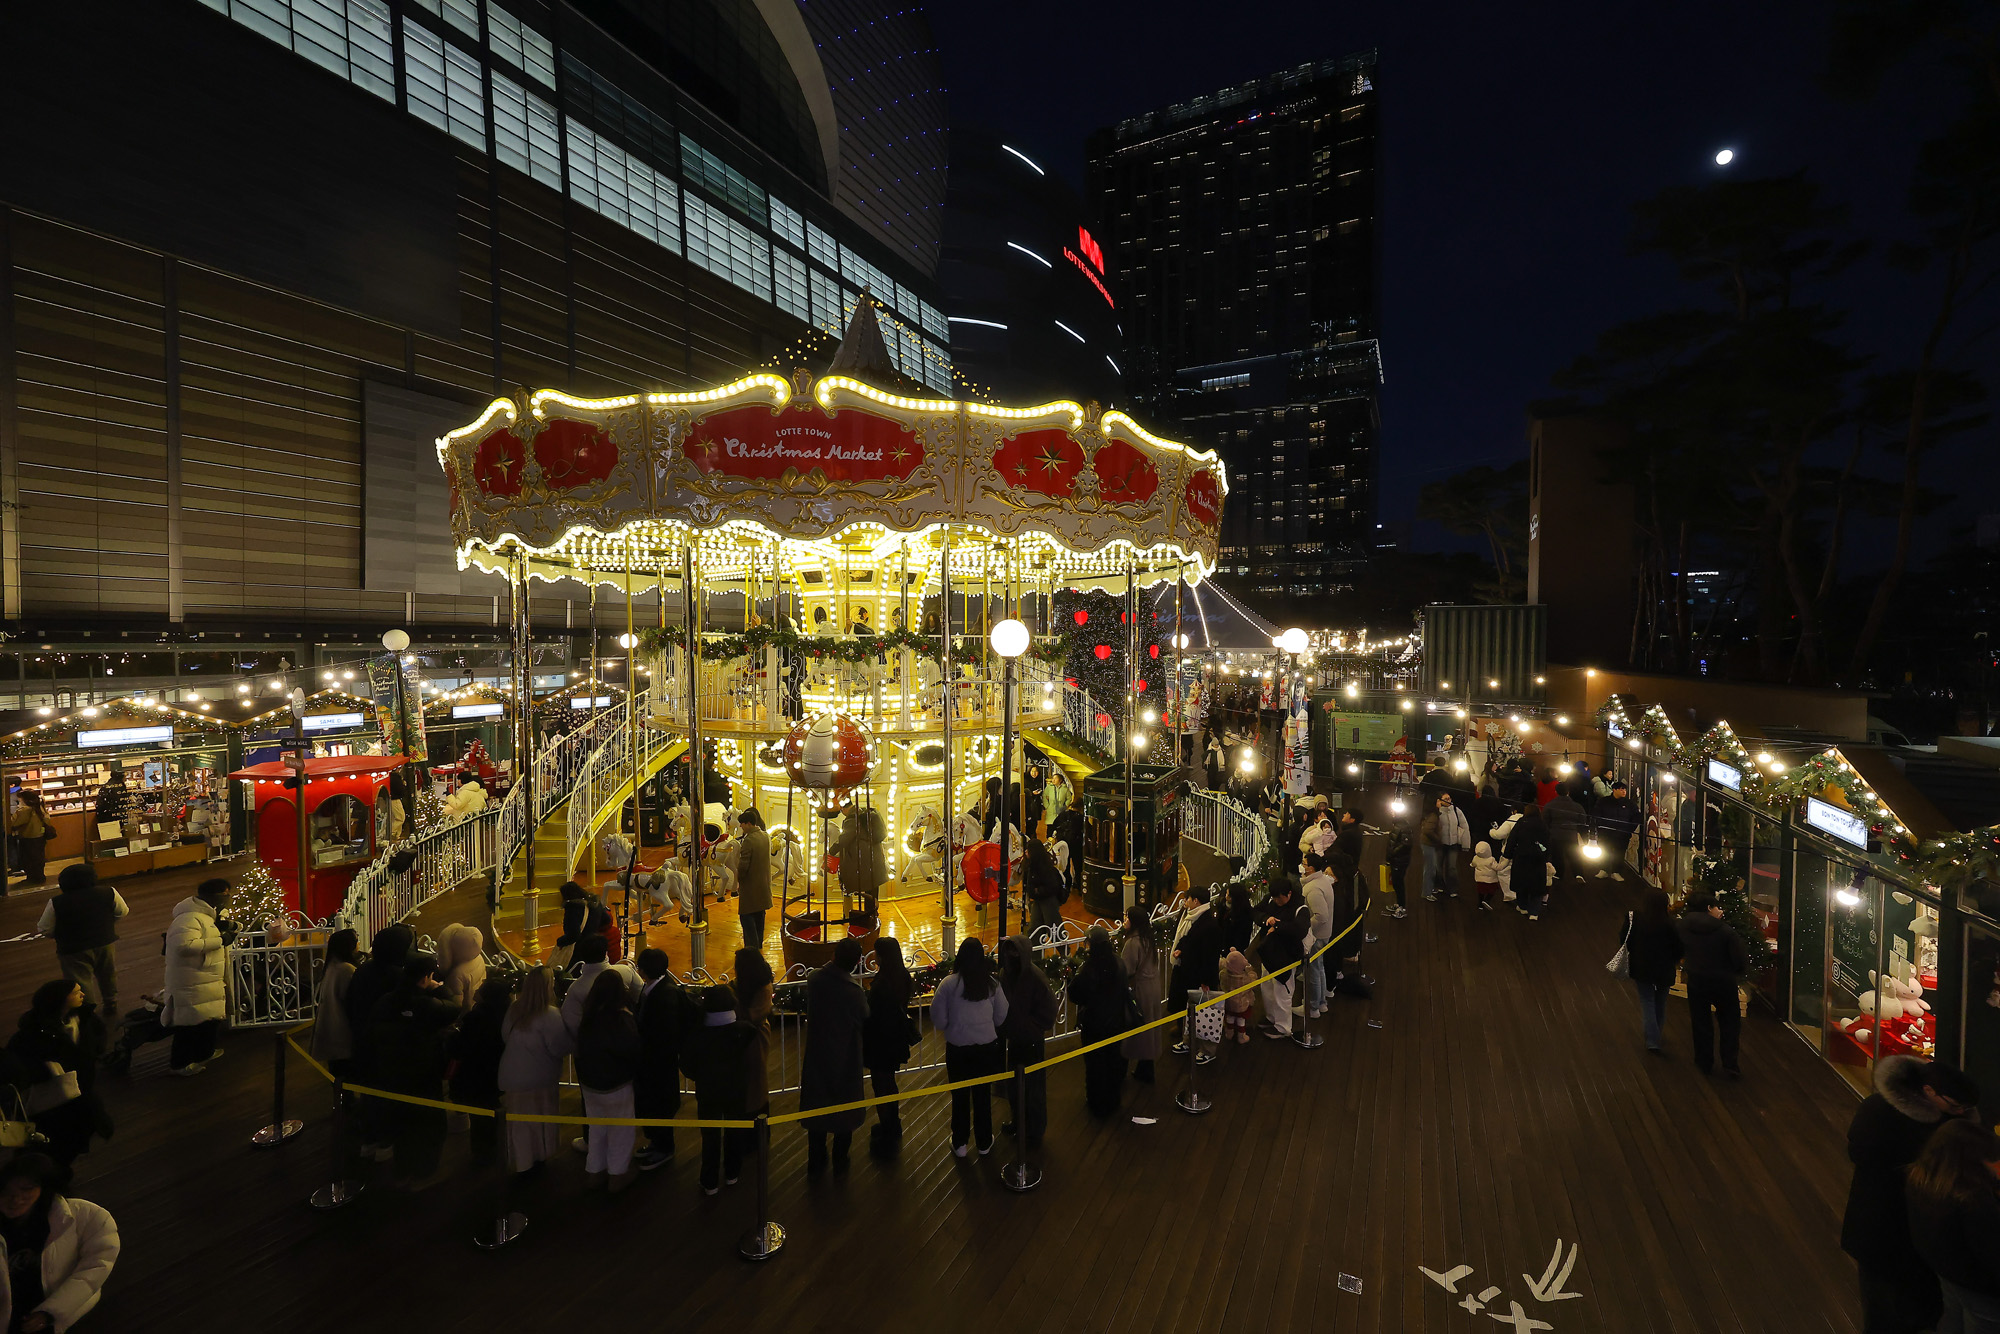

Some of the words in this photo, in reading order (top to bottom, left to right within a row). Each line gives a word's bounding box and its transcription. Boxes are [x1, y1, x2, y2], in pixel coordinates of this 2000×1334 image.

[1063, 246, 1085, 273] LOTTE
[1085, 266, 1103, 293] WORLD
[776, 427, 801, 437] LOTTE
[805, 427, 832, 439] TOWN
[723, 437, 821, 459] Christmas
[824, 444, 884, 461] Market
[1821, 809, 1831, 818] BON
[1831, 813, 1840, 823] TON
